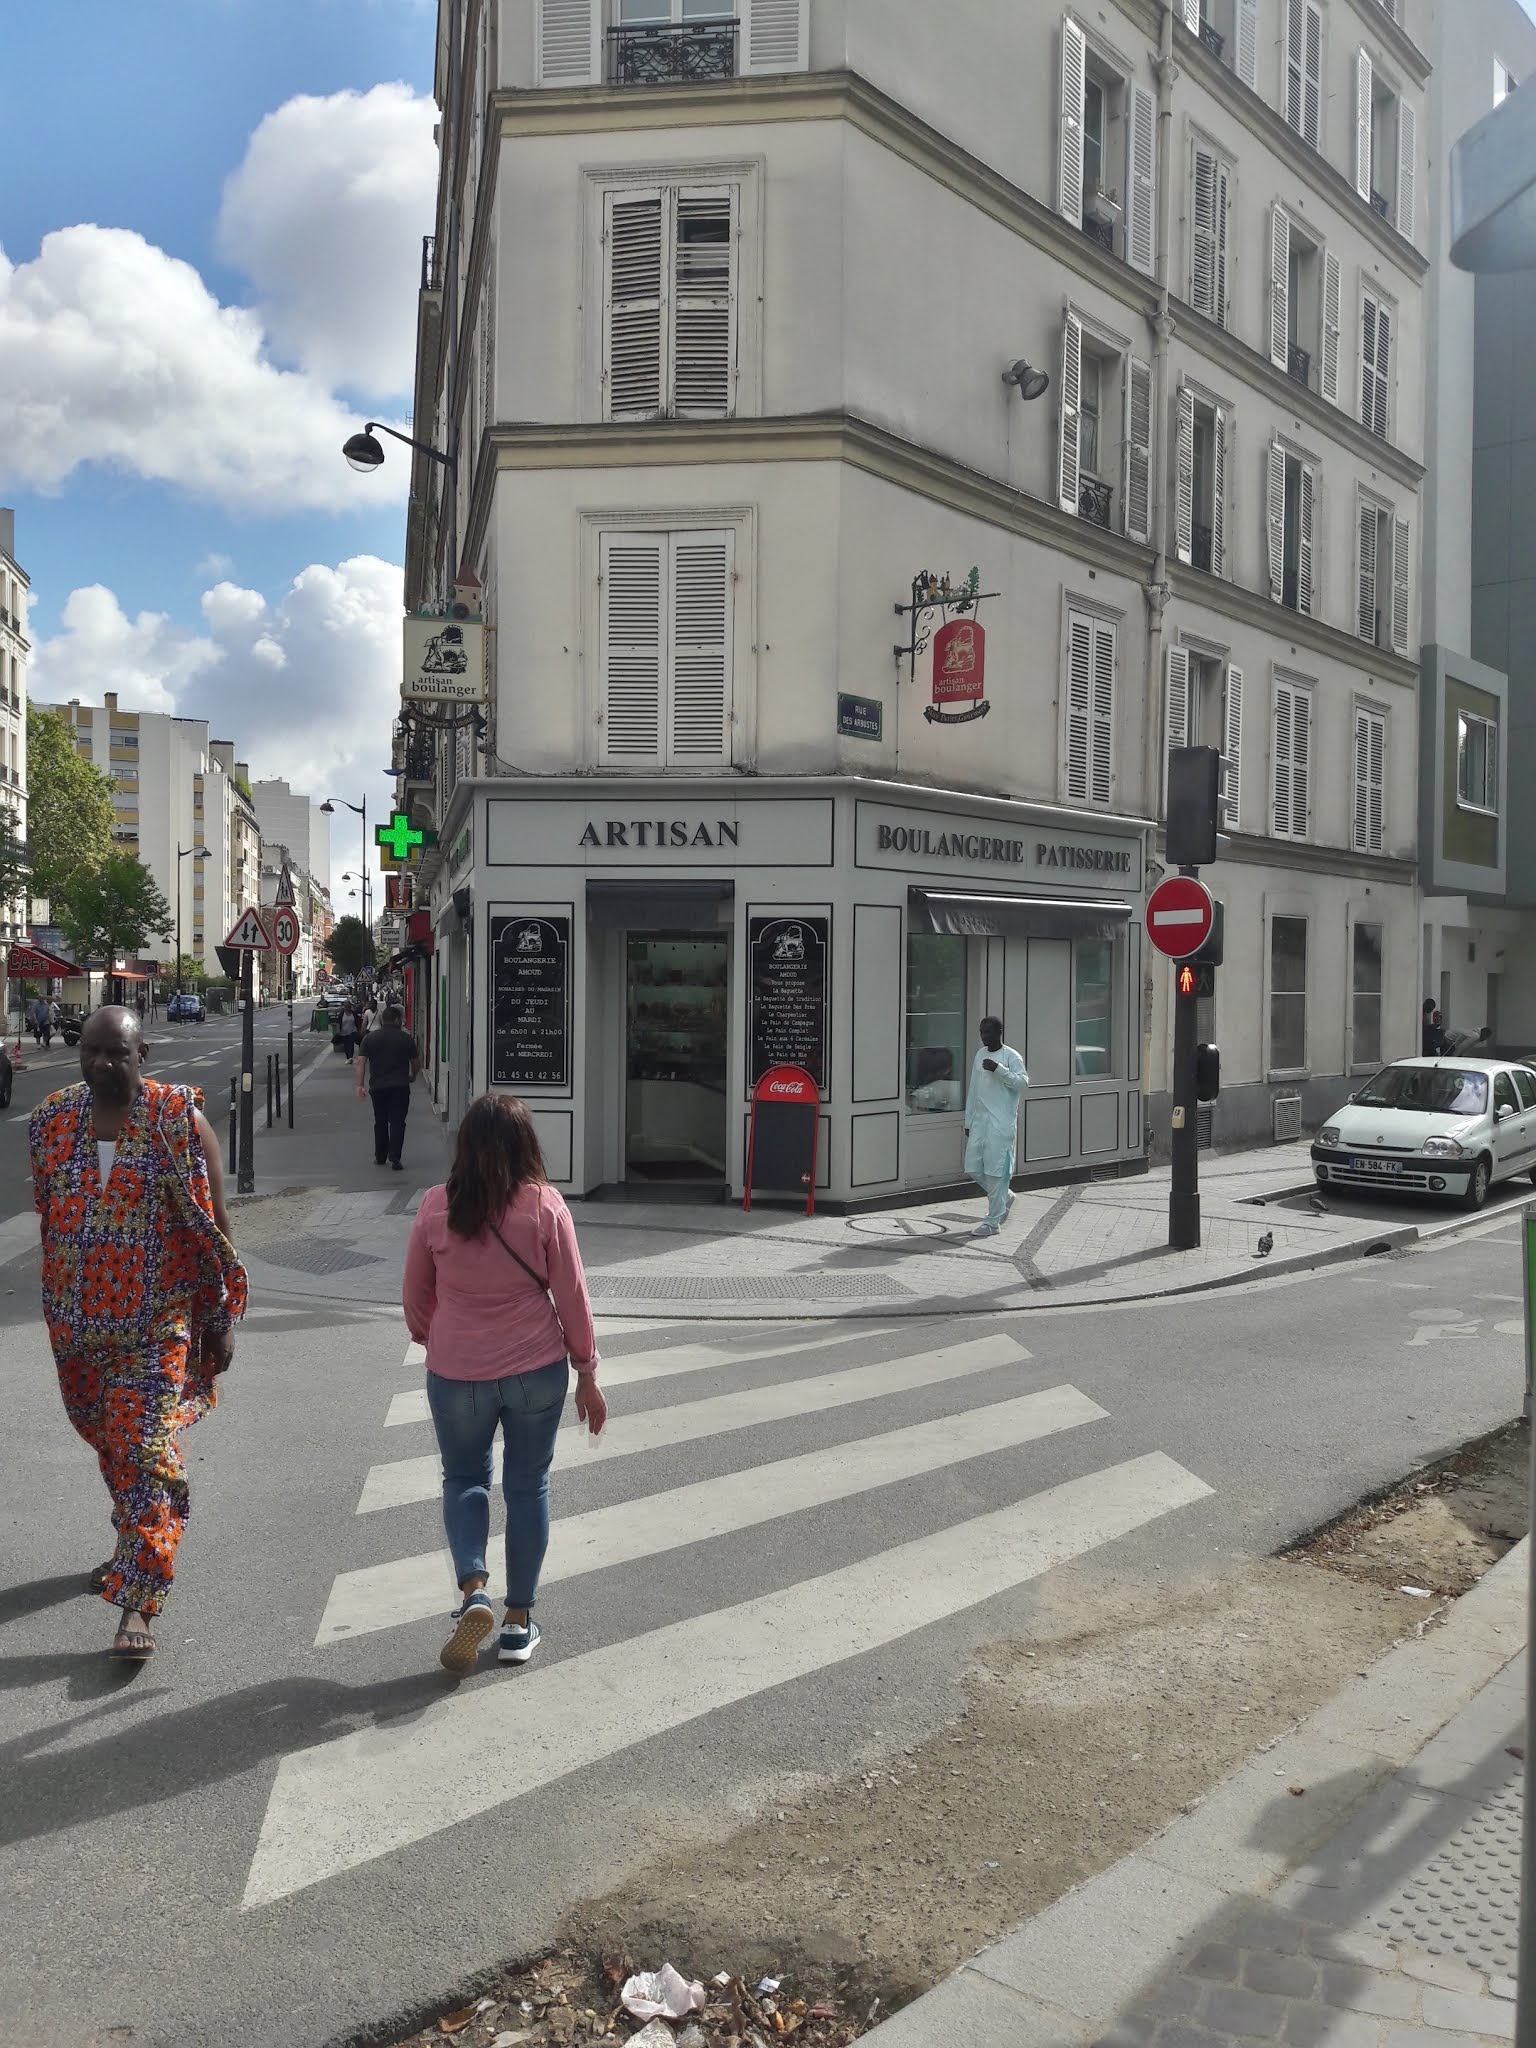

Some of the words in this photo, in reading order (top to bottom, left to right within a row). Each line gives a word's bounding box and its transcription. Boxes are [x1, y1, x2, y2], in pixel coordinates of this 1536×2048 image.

[418, 676, 452, 684] artisan
[939, 678, 964, 686] artisan
[412, 682, 476, 698] boulanger
[934, 682, 982, 694] boulanger
[854, 706, 866, 716] RUE
[842, 716, 852, 725] DES
[854, 718, 878, 730] ARBUSTES
[578, 821, 740, 847] ARTISAN
[878, 824, 1024, 864] BOULANGERIE
[1036, 843, 1132, 873] PATISSERIE
[278, 921, 292, 942] 30
[511, 1071, 520, 1079] 45
[552, 1072, 560, 1080] 56
[770, 1080, 804, 1094] Coca-Cola
[1355, 1159, 1397, 1172] EN-584-FK
